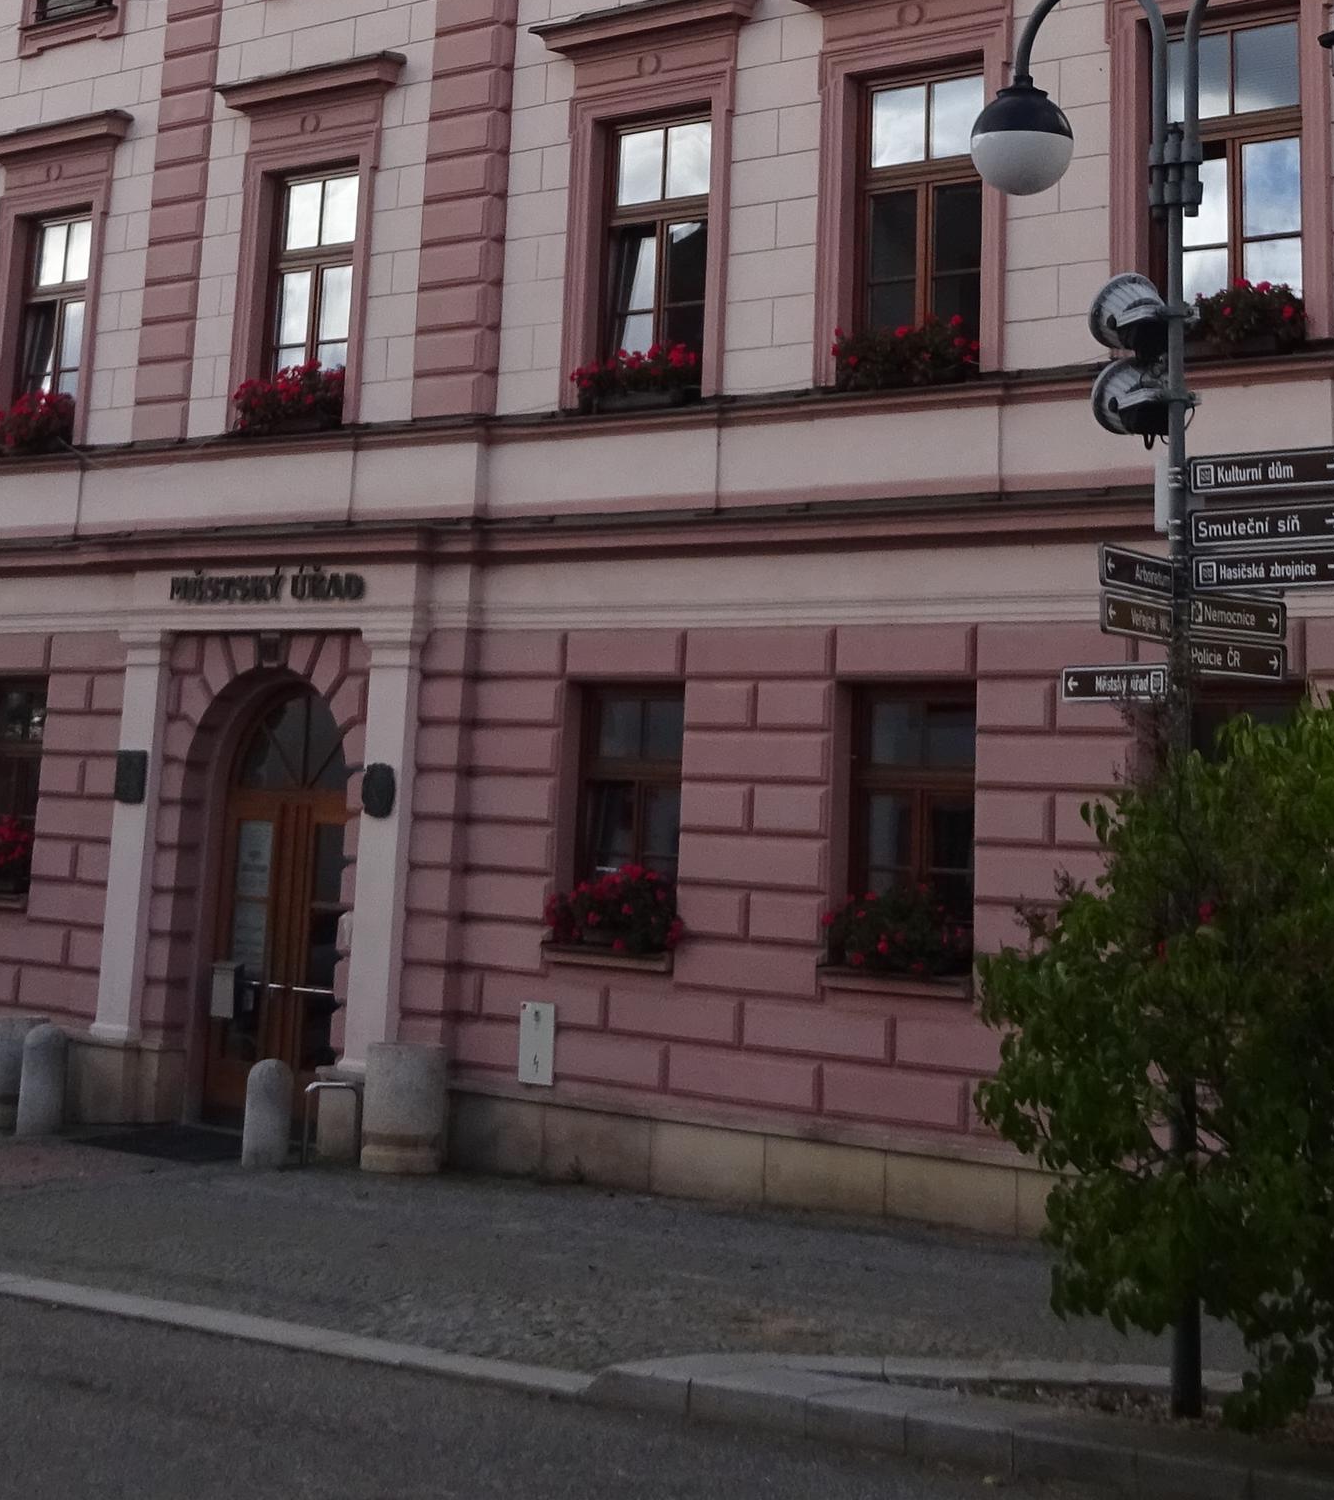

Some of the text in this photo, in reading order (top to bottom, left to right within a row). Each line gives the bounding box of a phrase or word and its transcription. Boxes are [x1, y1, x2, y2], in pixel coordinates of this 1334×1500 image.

[1217, 461, 1294, 483] Kulturní dům
[1198, 514, 1300, 537] Smuteční síň
[1135, 563, 1171, 585] Arboretum
[1219, 560, 1317, 580] Hasičská zbrojnice
[1204, 605, 1255, 626] Nemocnice
[1191, 646, 1240, 667] Policie ČR
[1095, 674, 1127, 695] Městský
